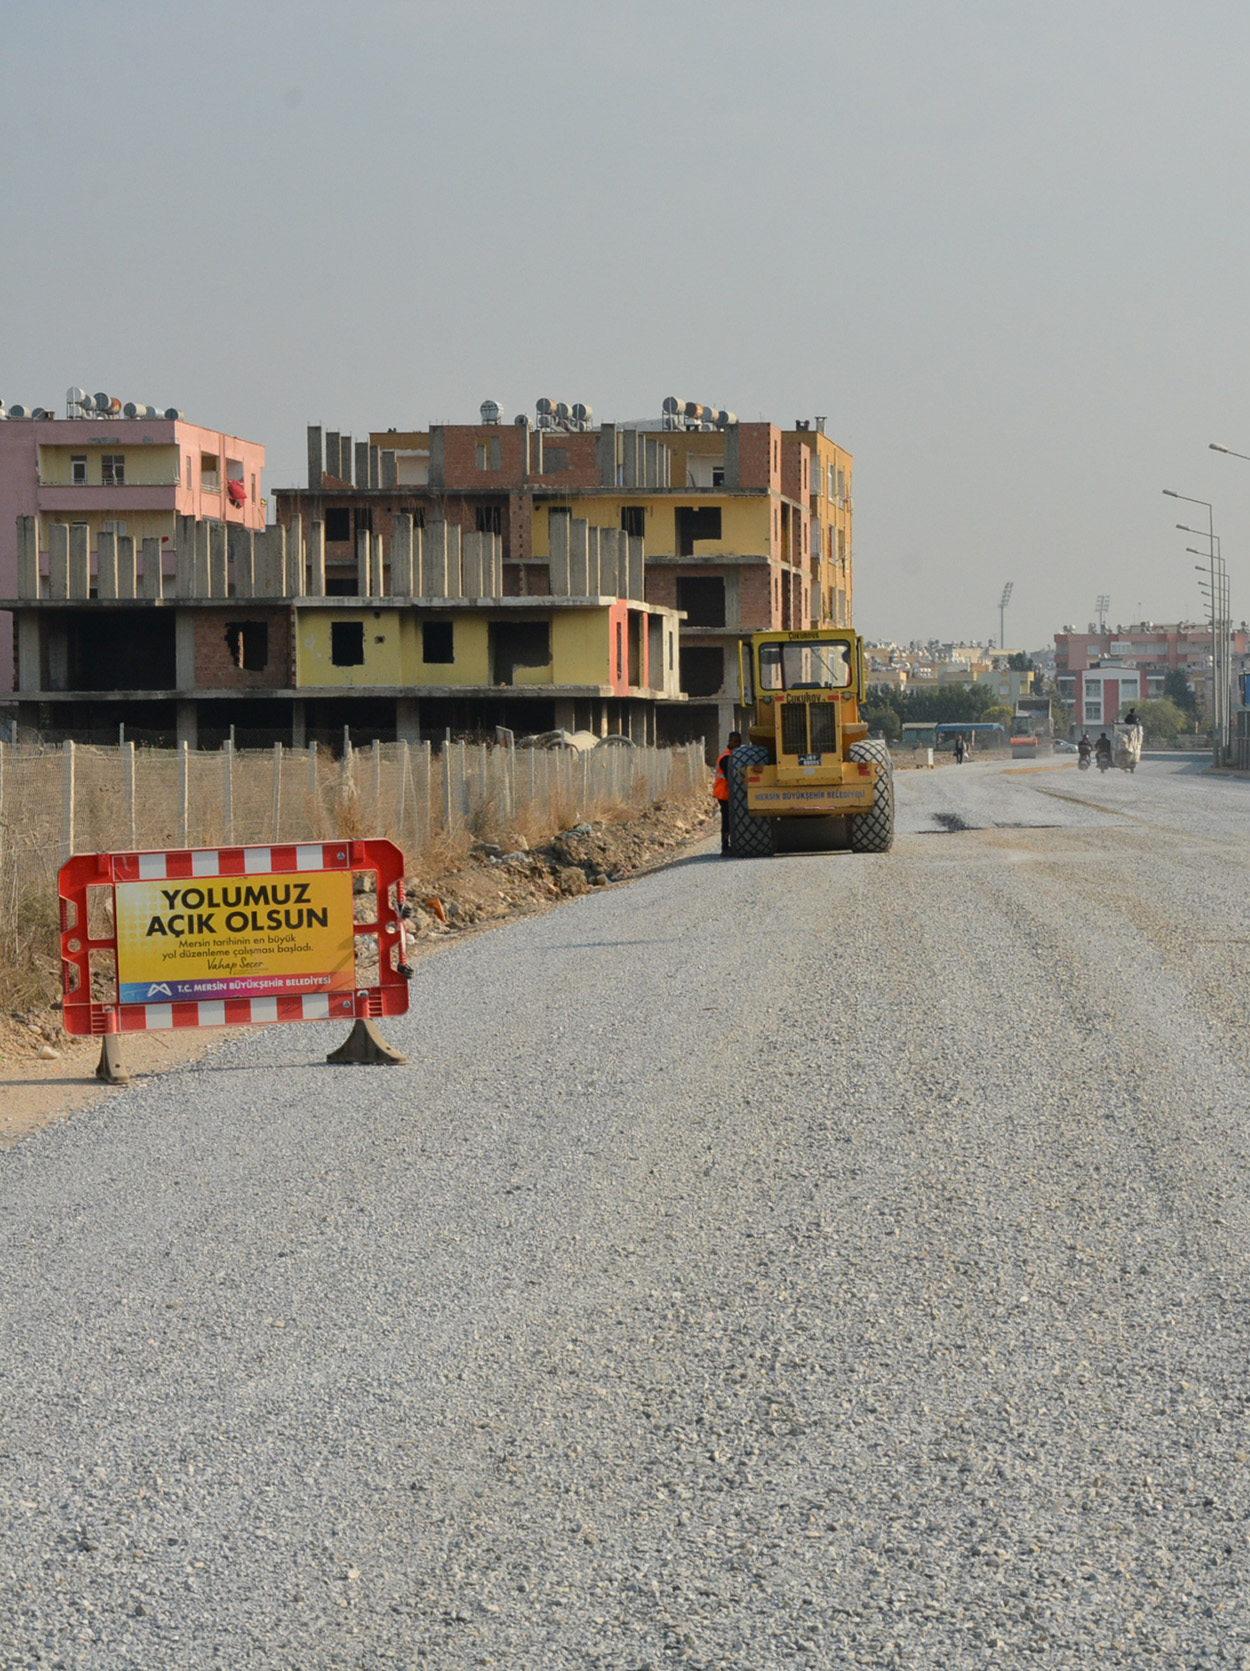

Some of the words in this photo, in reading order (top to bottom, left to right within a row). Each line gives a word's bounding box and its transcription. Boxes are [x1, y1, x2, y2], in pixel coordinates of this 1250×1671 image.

[160, 883, 312, 910] YOLUMUZ
[146, 913, 217, 938] AÇIK
[225, 907, 328, 933] OLSUN
[179, 939, 211, 948] Mersin
[213, 937, 250, 946] tarihinin
[267, 934, 296, 946] büyük
[162, 950, 177, 961] yol
[179, 948, 230, 959] düzenleme
[233, 946, 275, 958] çalışması
[207, 958, 237, 974] Vahap
[177, 984, 192, 993] T.C.
[194, 982, 227, 991] MERSİN
[229, 978, 283, 990] BÜYÜKŞEHİR
[286, 975, 331, 986] BELEDİYESİ
